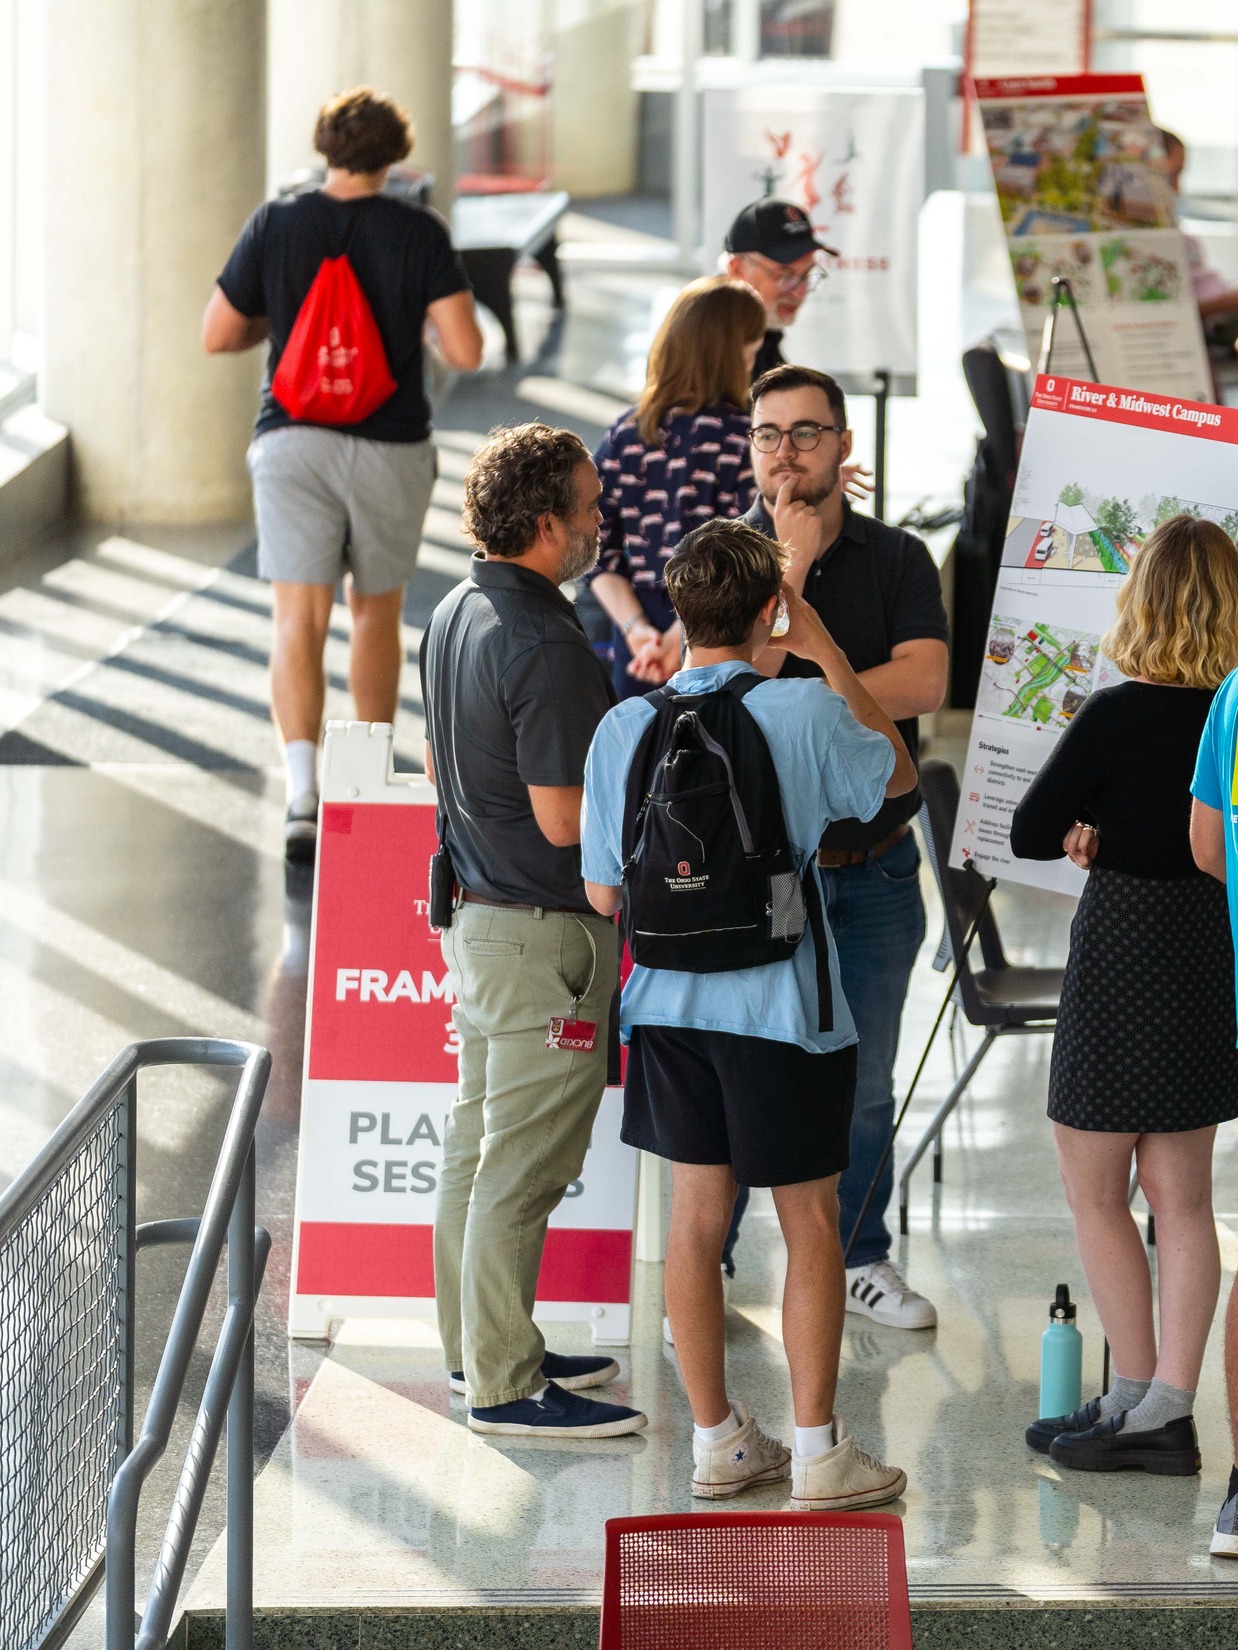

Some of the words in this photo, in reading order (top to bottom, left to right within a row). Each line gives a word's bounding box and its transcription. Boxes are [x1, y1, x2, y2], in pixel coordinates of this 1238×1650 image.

[1071, 385, 1106, 406] River
[1107, 396, 1118, 408] &
[1118, 394, 1172, 418] Midwest
[1172, 403, 1222, 428] Campus
[978, 741, 1009, 755] Strategies
[691, 874, 710, 882] STATE
[670, 881, 705, 889] UNIVERSITY
[335, 968, 456, 1004] FRAM
[559, 1037, 594, 1049] BUCKID
